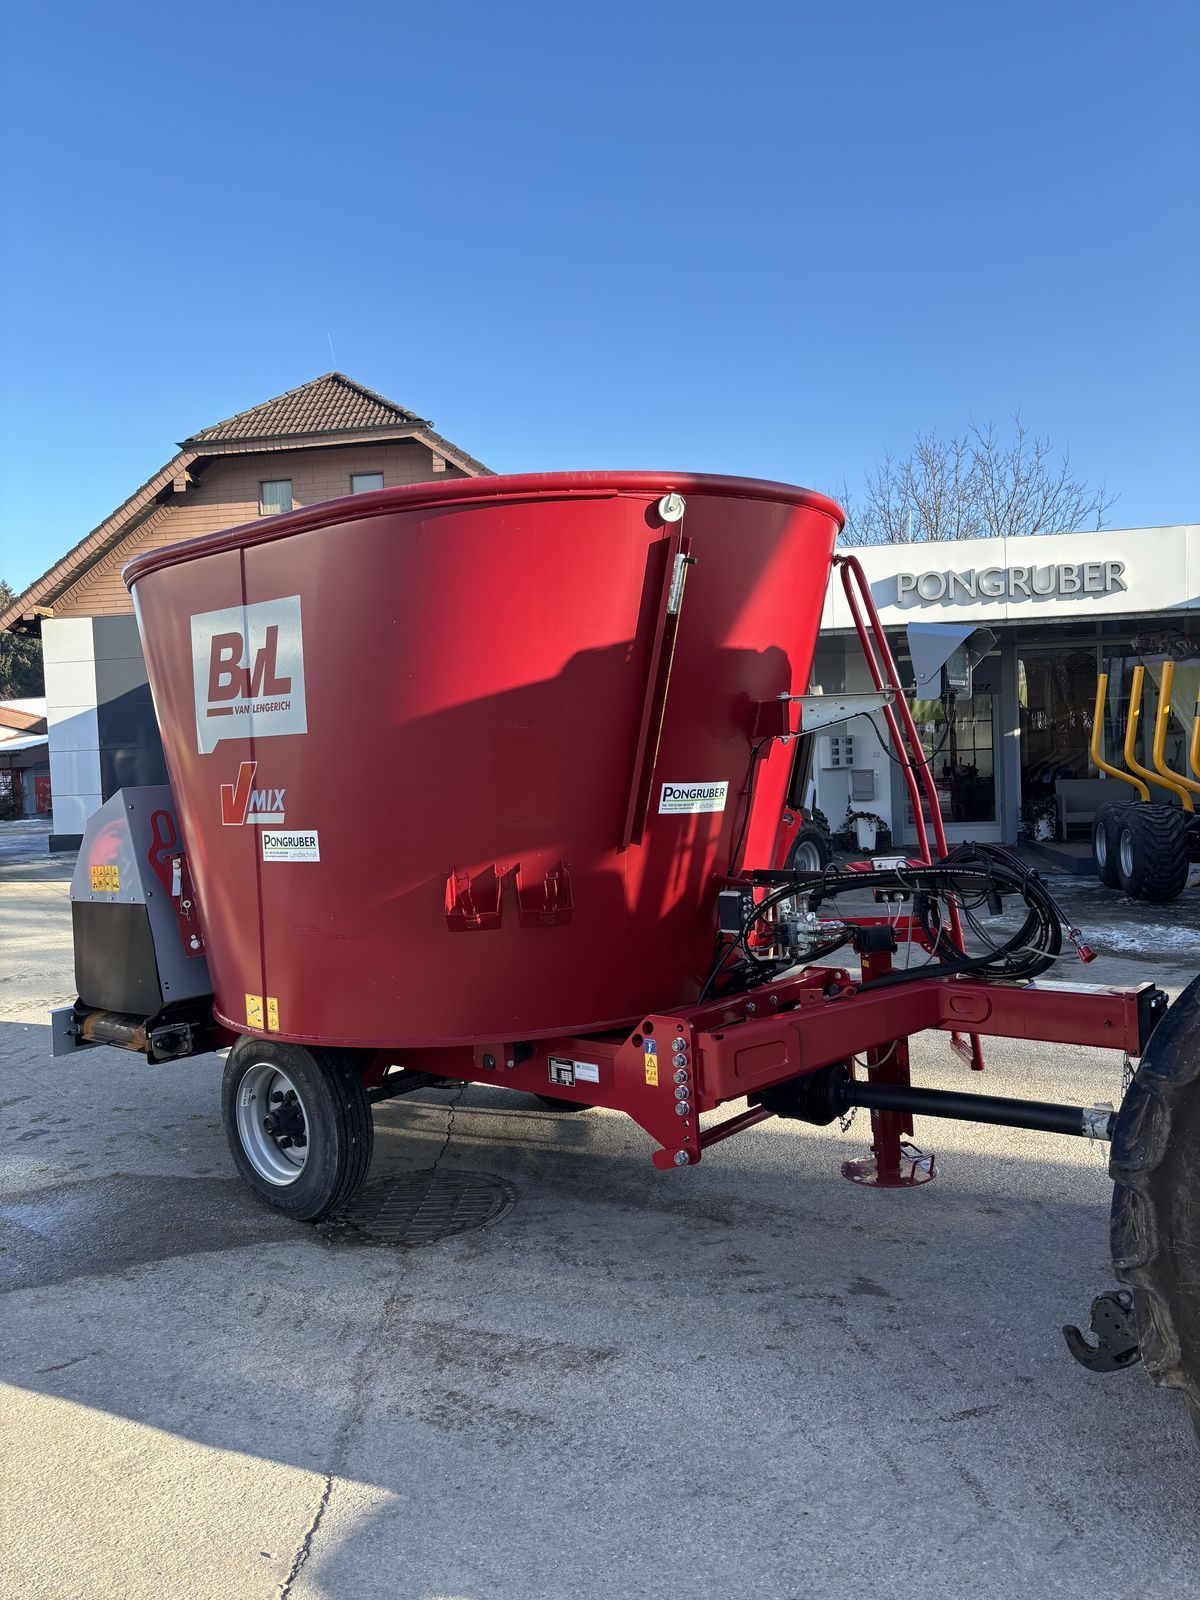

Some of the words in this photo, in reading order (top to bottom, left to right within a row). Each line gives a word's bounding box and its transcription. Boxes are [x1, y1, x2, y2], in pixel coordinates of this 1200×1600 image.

[896, 560, 1128, 602] PONGRUBER
[234, 705, 250, 715] VAN
[252, 702, 291, 713] LENGERICH
